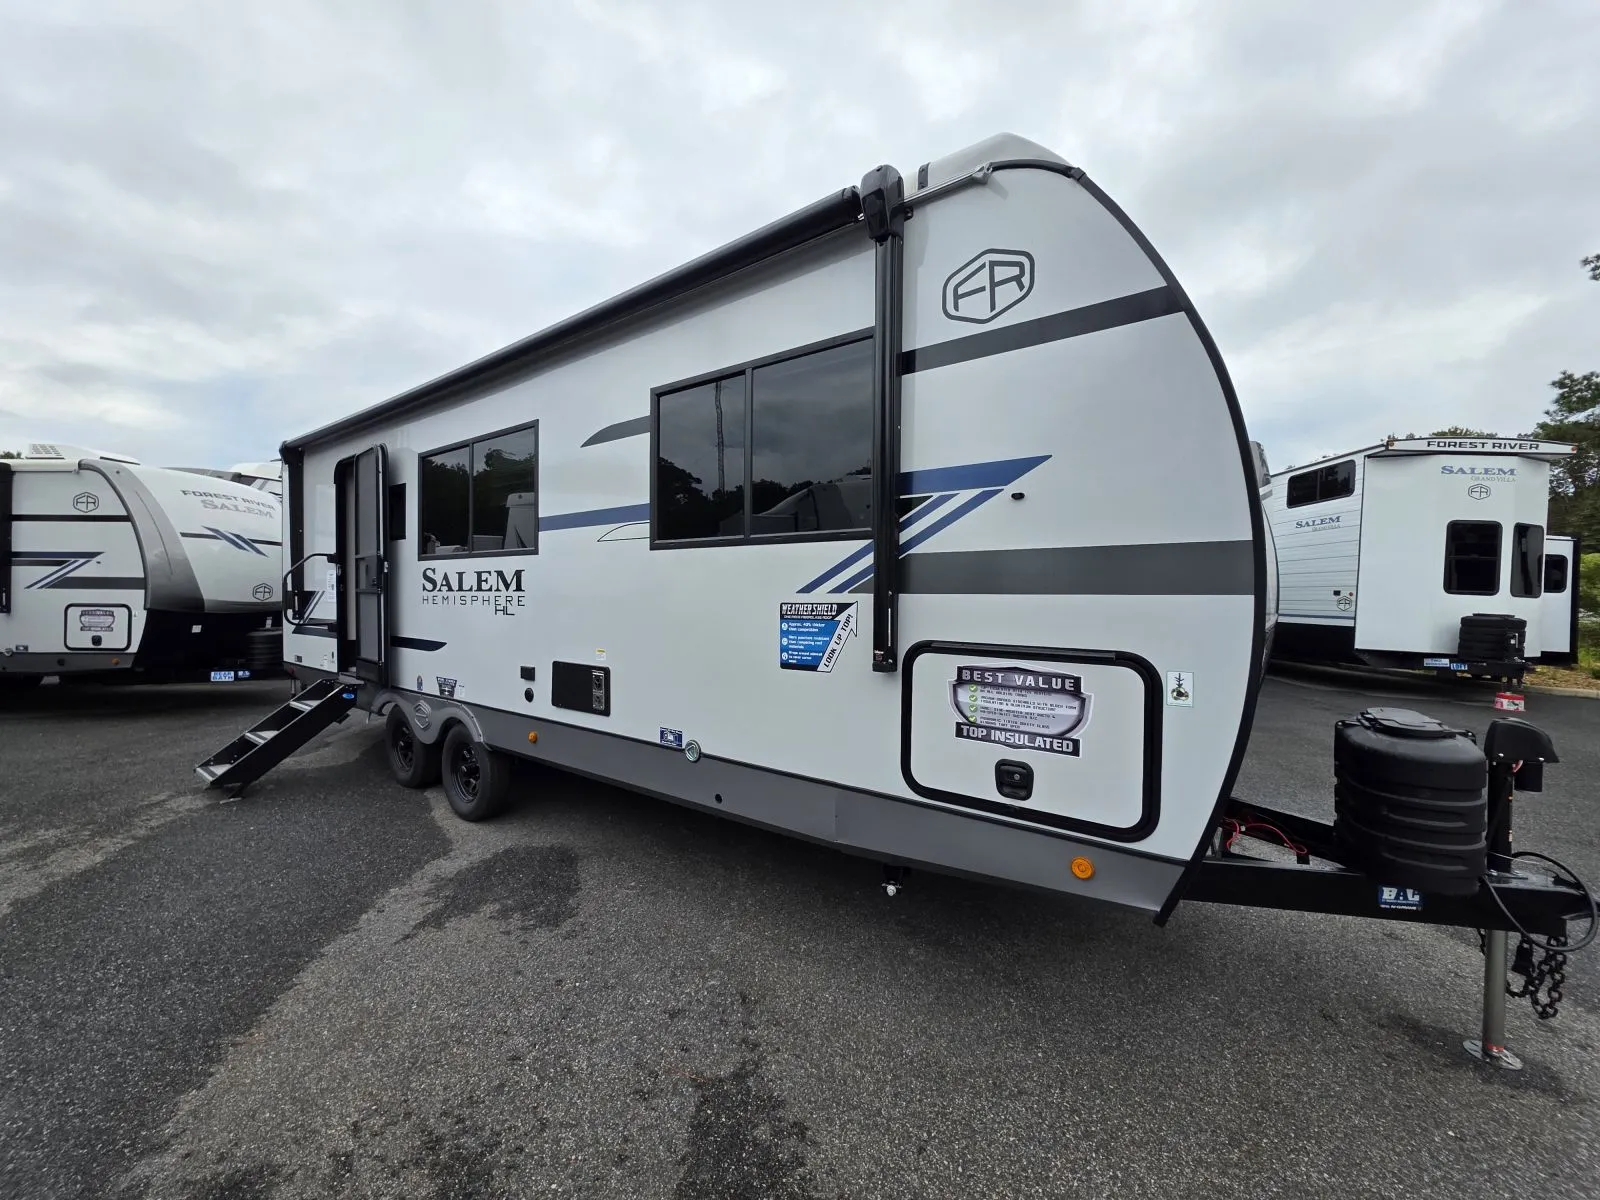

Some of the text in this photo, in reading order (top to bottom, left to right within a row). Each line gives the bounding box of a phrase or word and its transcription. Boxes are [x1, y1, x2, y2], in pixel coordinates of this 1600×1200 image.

[1427, 441, 1539, 450] FOREST RIVER
[1441, 465, 1517, 476] SALEM
[180, 489, 276, 511] FOREST RIVER
[200, 499, 274, 518] SALEM
[1295, 516, 1342, 529] SALEM
[422, 567, 525, 593] SALEM
[422, 595, 525, 607] HEMISPHERE
[781, 603, 838, 615] WEATHER SHIELD
[494, 605, 516, 616] HL
[823, 613, 854, 668] LOOK UP TOP!
[961, 669, 1075, 690] BEST VALUE
[960, 725, 1073, 753] TOP INSULATED
